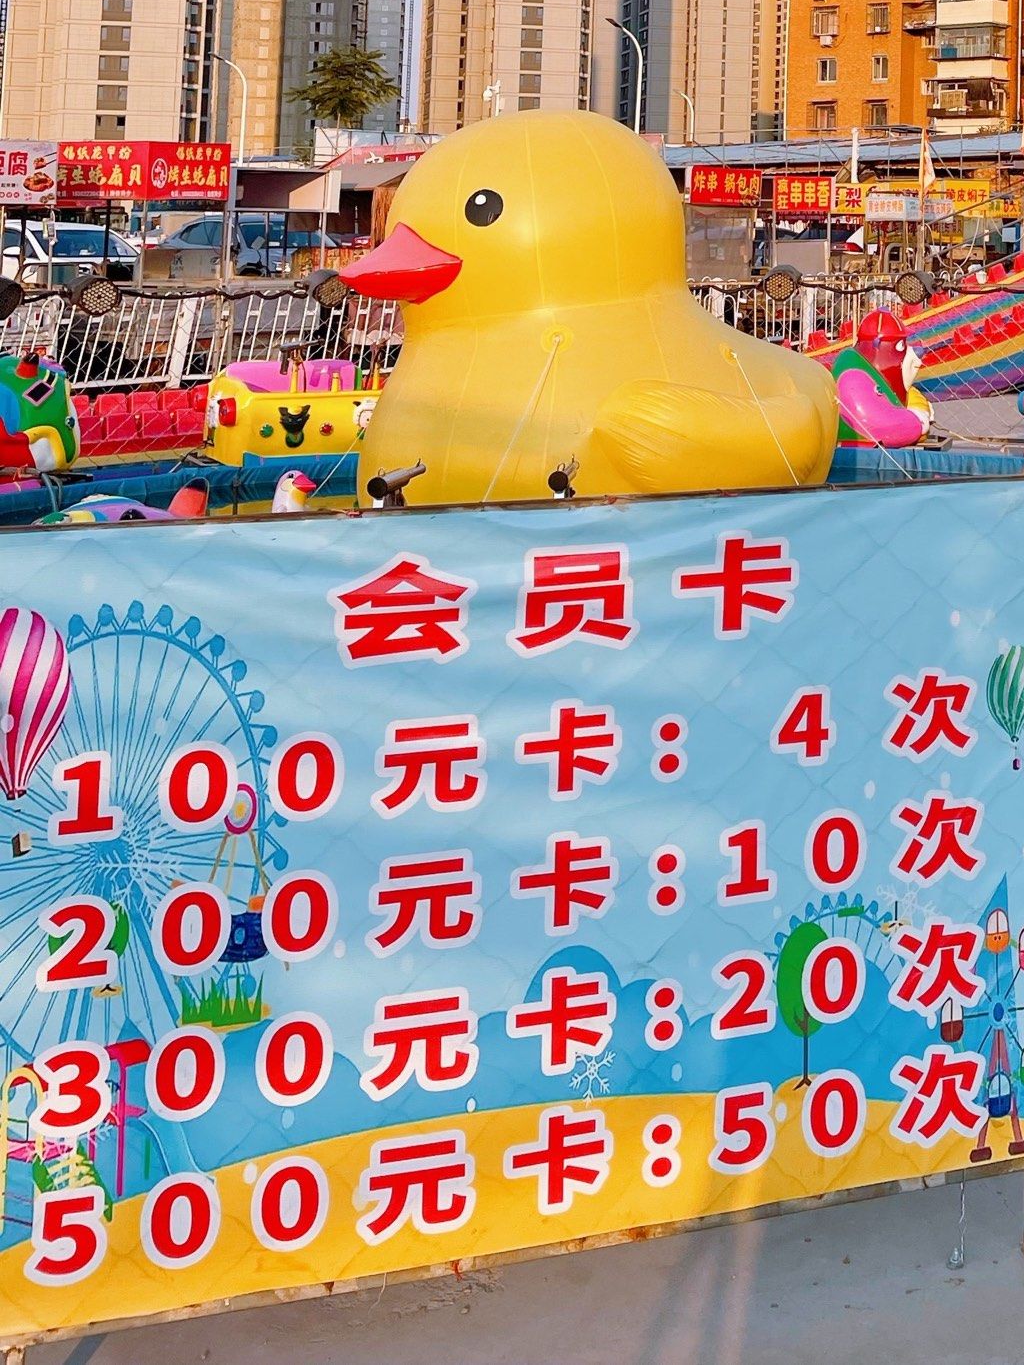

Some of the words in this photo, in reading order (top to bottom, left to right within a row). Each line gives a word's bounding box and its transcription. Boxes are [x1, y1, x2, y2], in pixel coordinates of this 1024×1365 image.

[693, 171, 718, 193] 炸串
[725, 172, 760, 195] 锅包肉
[790, 180, 829, 207] 串串香
[338, 538, 793, 660] 会员卡
